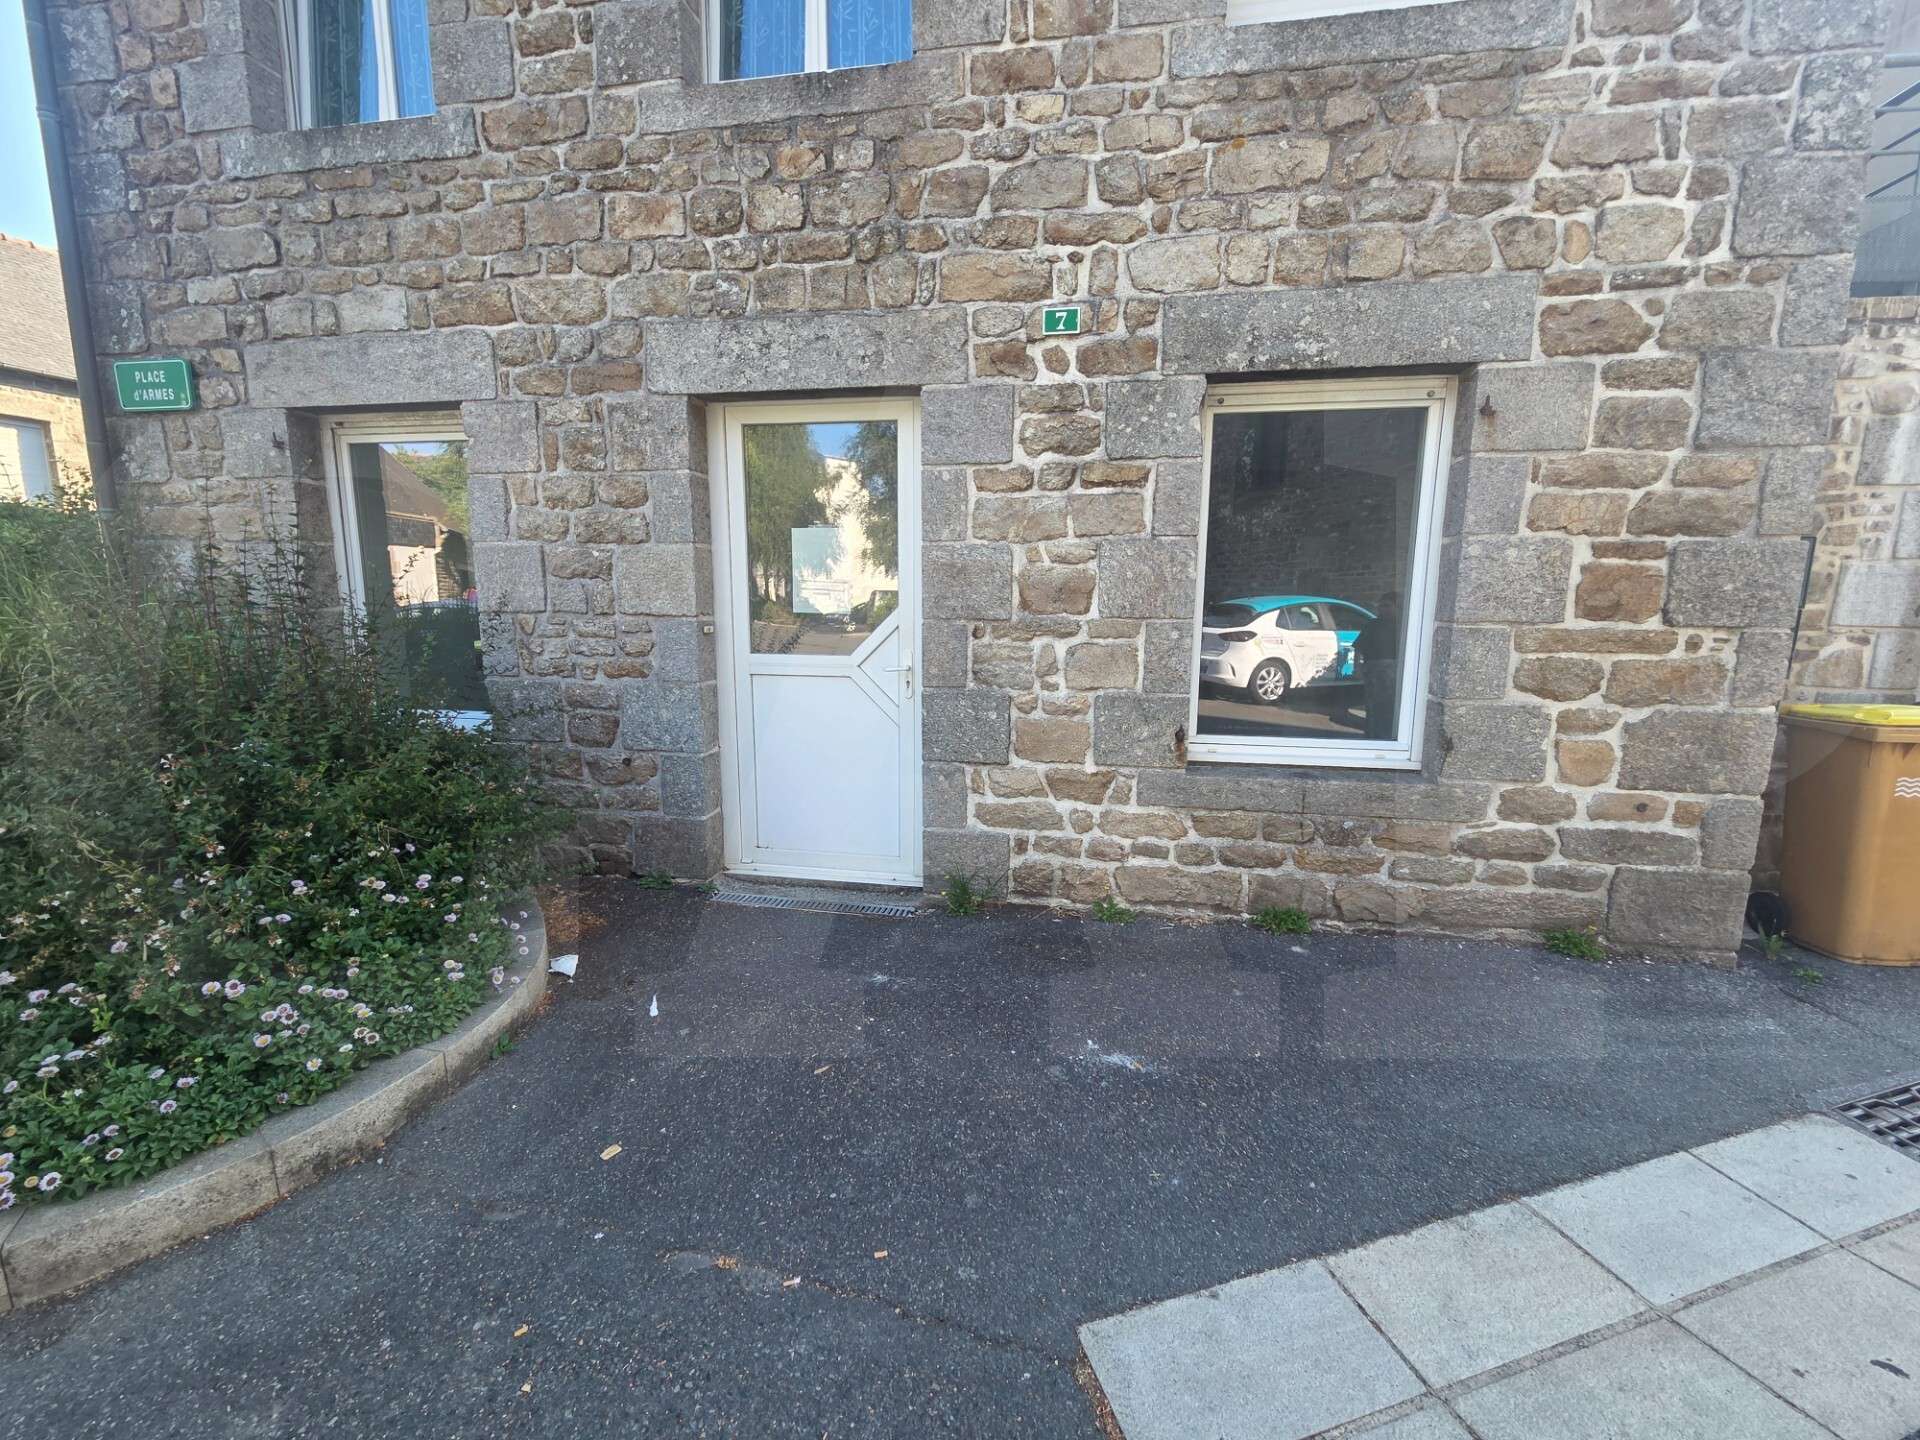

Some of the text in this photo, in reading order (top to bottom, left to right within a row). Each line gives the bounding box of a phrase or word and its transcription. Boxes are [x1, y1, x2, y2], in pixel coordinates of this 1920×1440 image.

[1055, 311, 1068, 330] 7
[134, 370, 166, 383] PLACE
[134, 388, 175, 401] d'ARMES
